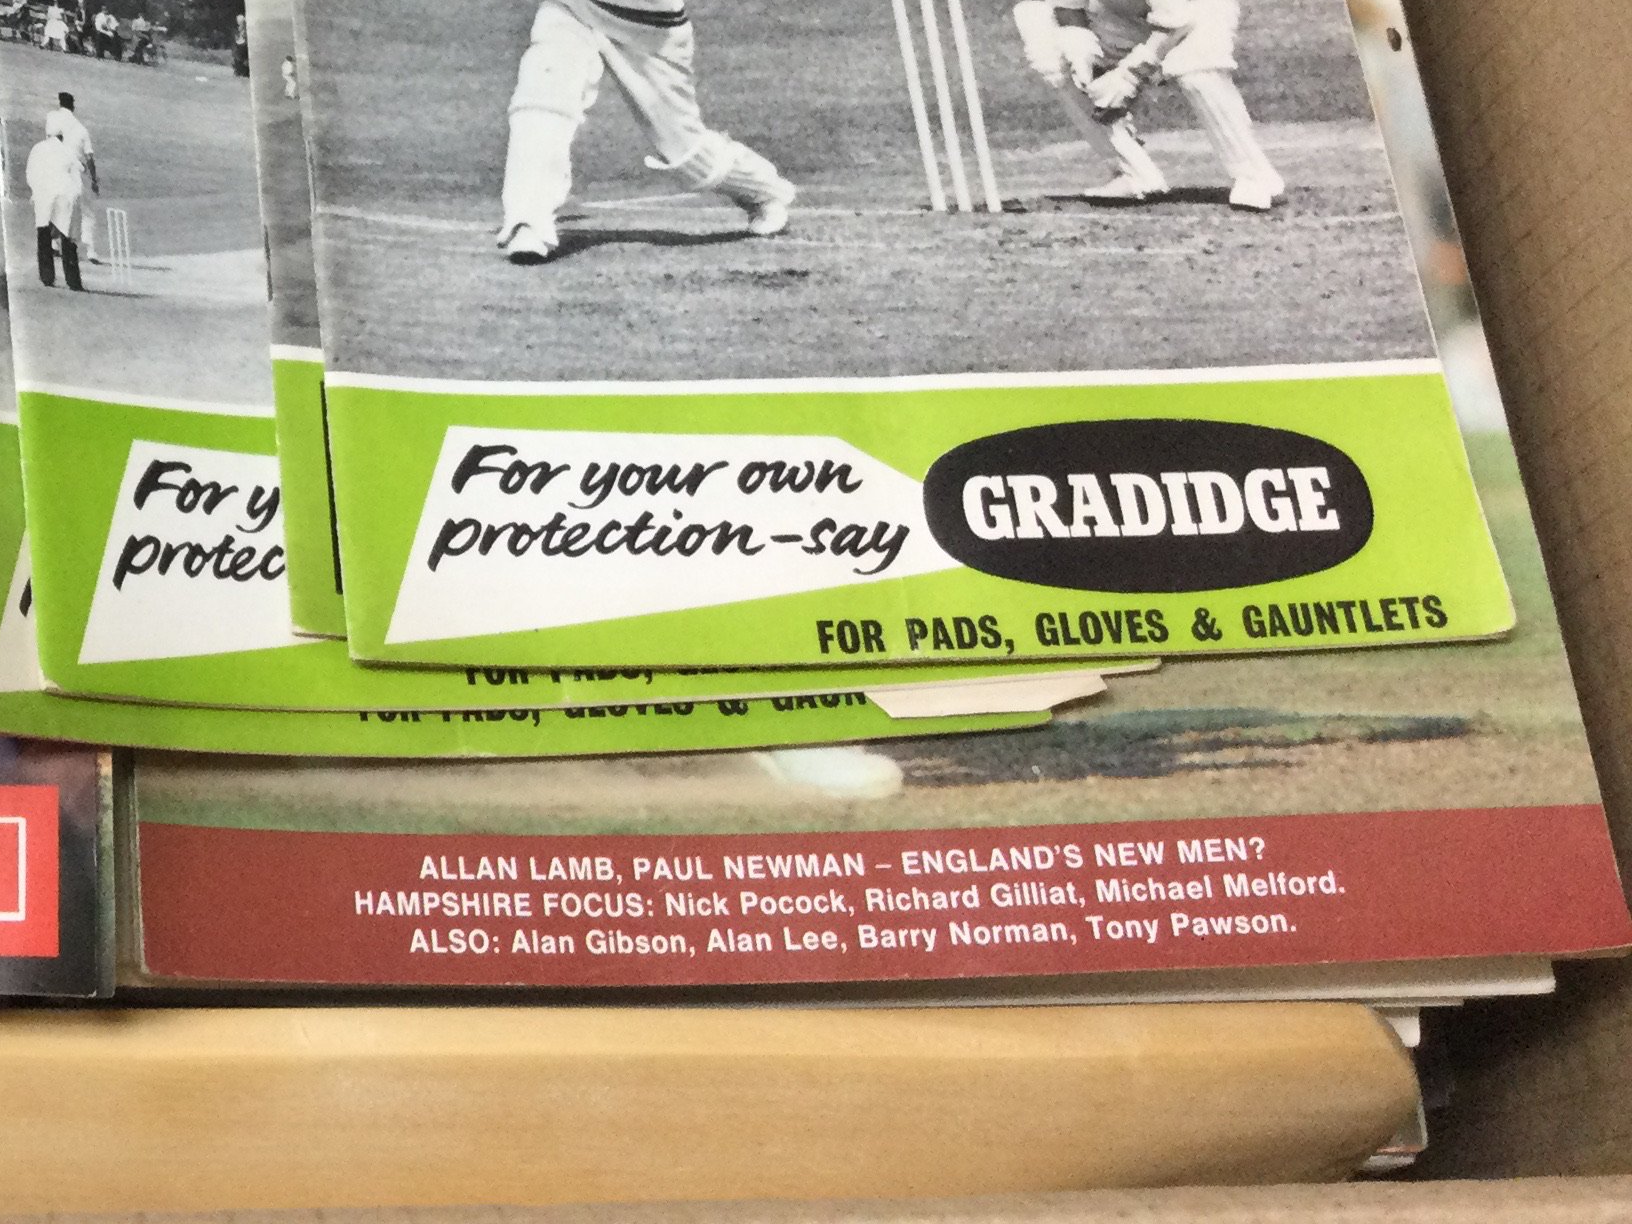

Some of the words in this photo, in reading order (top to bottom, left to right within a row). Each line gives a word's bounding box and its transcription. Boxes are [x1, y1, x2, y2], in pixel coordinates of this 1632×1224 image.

[133, 459, 239, 514] For
[451, 443, 571, 494] For
[568, 459, 728, 509] your
[737, 459, 862, 494] own
[963, 466, 1339, 541] GRADIDGE
[816, 620, 886, 654] FOR
[905, 614, 1015, 655] PADS,
[1035, 609, 1169, 647] GLOVES
[1191, 607, 1223, 641] &
[1242, 595, 1448, 639] GAUNTLETS
[419, 856, 518, 881] ALLAN
[530, 856, 623, 886] LAMB,
[633, 854, 713, 880] PAUL
[724, 852, 865, 878] NEWMAN
[902, 843, 1084, 875] ENGLAND'S
[1095, 841, 1165, 868] NEW
[1177, 837, 1266, 864] MEN?
[355, 890, 531, 917] HAMPSHIRE
[543, 891, 654, 918] FOCUS:
[666, 890, 730, 916] Nick
[741, 889, 856, 918] Pocock,
[867, 884, 980, 914] Richard
[991, 880, 1087, 910] Gilliat,
[1096, 875, 1213, 904] Michael
[1224, 870, 1346, 898] Melford.
[410, 928, 501, 954] ALSO:
[511, 928, 574, 954] Alan
[585, 928, 696, 958] Gibson,
[706, 926, 772, 953] Alan
[783, 925, 847, 954] Lee,
[857, 923, 937, 953] Barry
[949, 919, 1078, 947] Norman,
[1085, 914, 1160, 944] Tony
[1170, 910, 1298, 938] Pawson.
